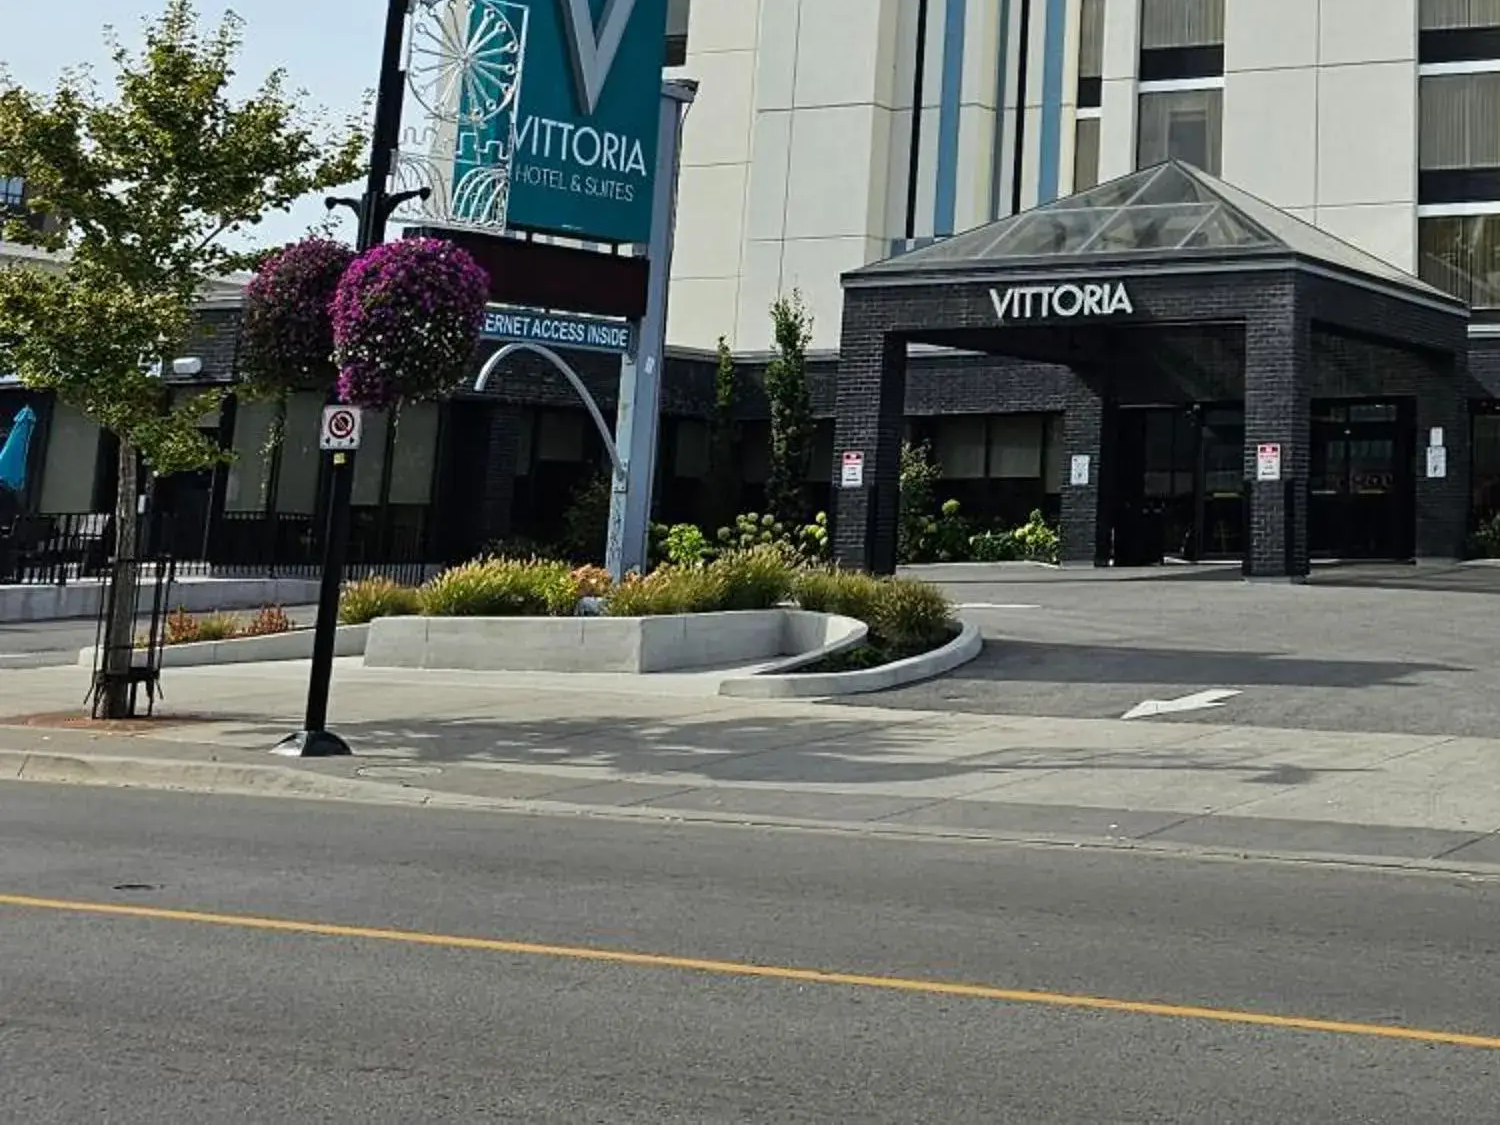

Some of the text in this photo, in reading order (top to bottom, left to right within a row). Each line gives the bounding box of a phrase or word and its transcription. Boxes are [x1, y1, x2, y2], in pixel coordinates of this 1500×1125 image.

[512, 115, 647, 176] VITTORIA
[515, 162, 634, 202] HOTEL & SUITES
[989, 282, 1133, 319] VITTORIA
[480, 312, 629, 346] ERNET ACCESS INSIDE
